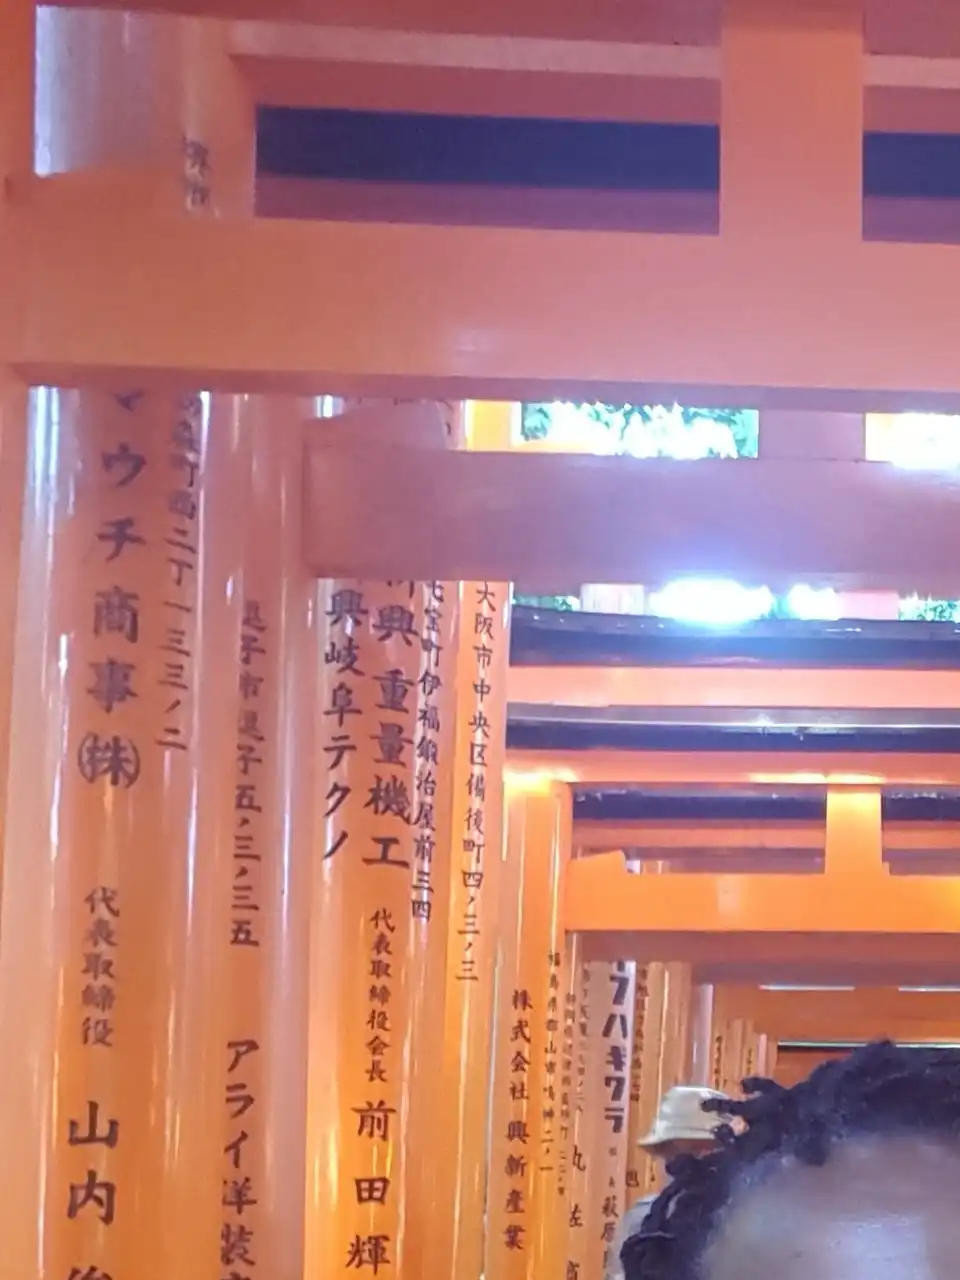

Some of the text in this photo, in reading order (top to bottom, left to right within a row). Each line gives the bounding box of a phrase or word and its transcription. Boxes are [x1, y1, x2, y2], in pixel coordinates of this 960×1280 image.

[81, 886, 120, 1047] 代表取締役
[366, 907, 396, 1084] 代表取締役会長
[510, 989, 533, 1101] 株式会社
